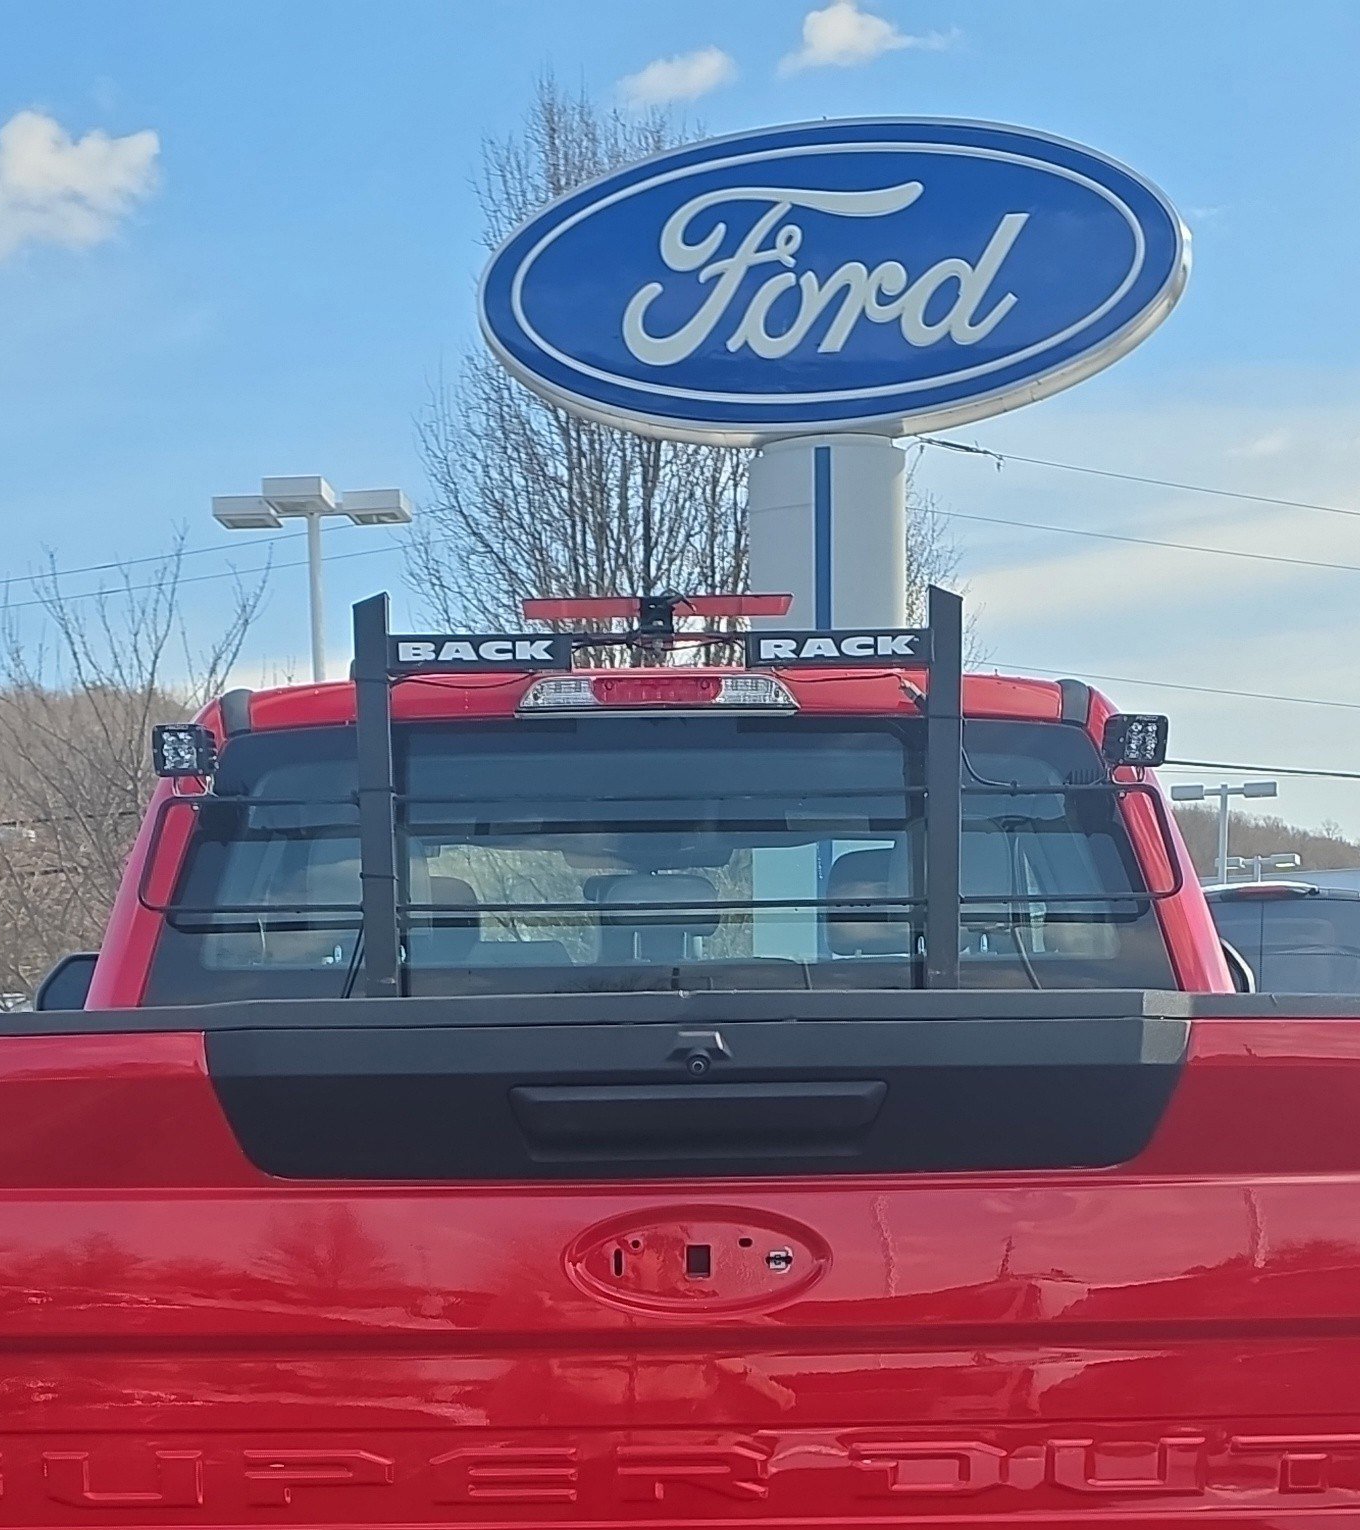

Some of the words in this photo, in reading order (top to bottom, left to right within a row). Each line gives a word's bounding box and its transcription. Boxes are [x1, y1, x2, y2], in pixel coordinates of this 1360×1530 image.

[622, 180, 1030, 366] Ford
[398, 640, 554, 662] BACK
[759, 634, 918, 660] RACK
